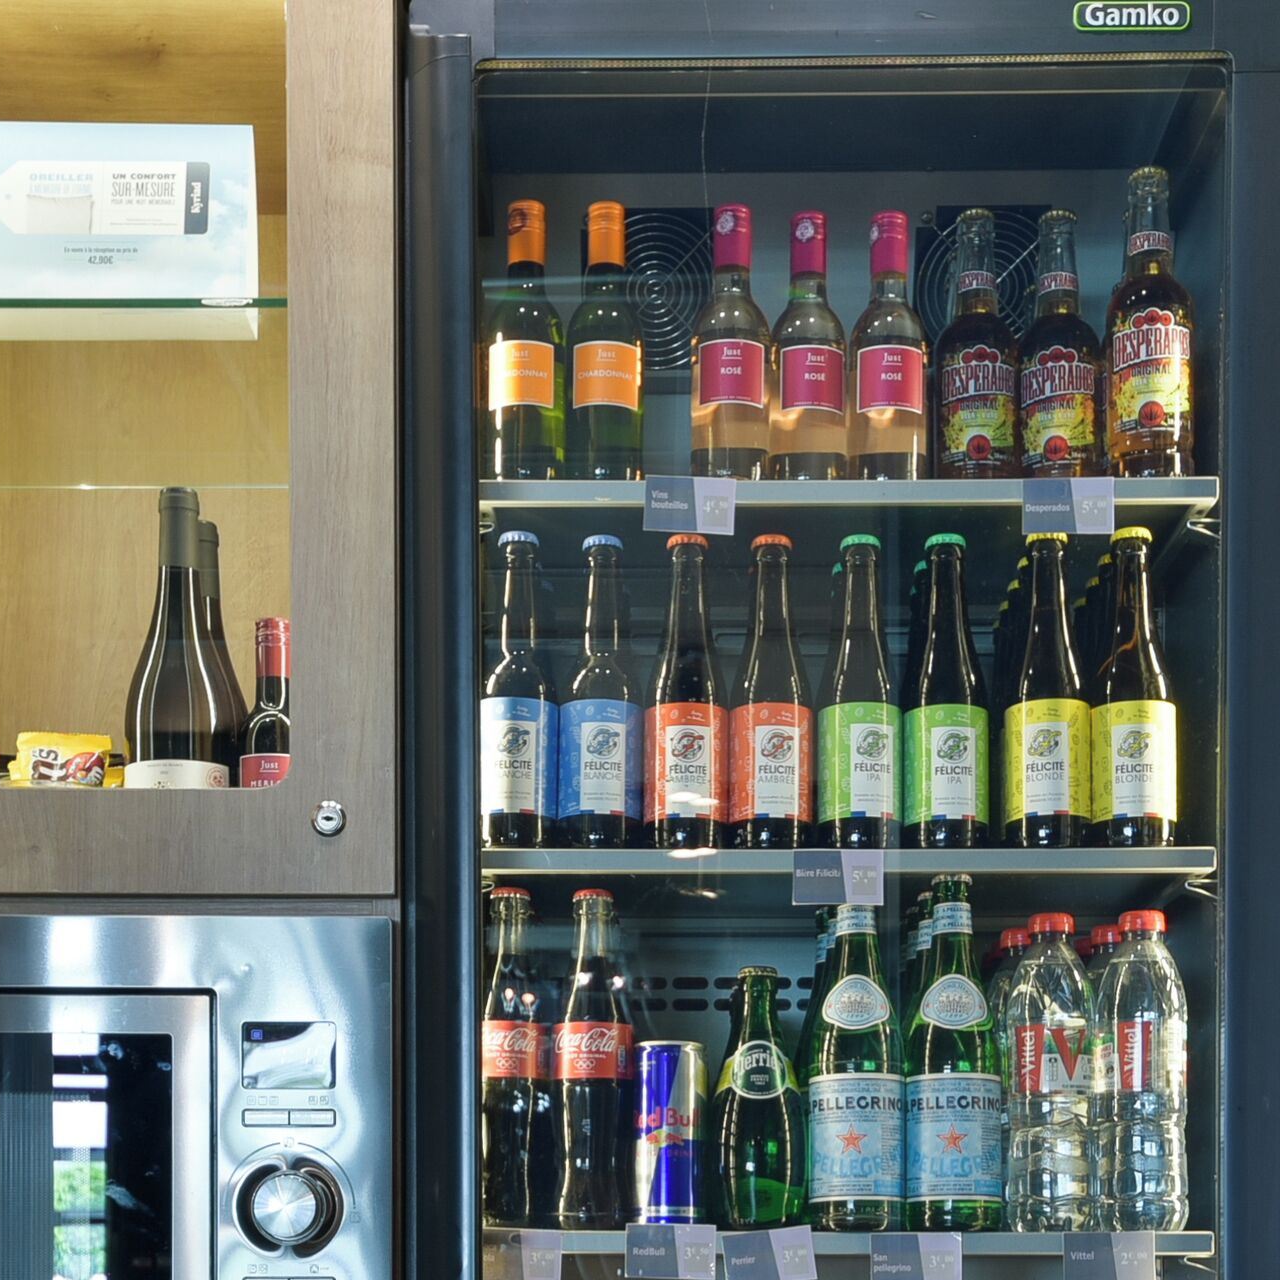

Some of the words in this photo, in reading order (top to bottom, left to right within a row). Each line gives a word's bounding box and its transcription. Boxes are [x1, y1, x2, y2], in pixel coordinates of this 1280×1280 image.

[1084, 3, 1180, 26] Gamko
[112, 172, 124, 180] UN
[130, 172, 176, 180] CONFORT
[111, 181, 176, 198] SUR-MESURE
[190, 181, 203, 214] Kyriad
[722, 346, 742, 357] Just
[806, 352, 826, 363] Just
[883, 352, 902, 363] Just
[720, 365, 742, 375] ROSÉ
[804, 371, 826, 382] ROSÉ
[880, 371, 903, 381] ROSÉ
[1021, 364, 1095, 406] DESPERADOS
[1024, 503, 1071, 515] Desperados
[260, 759, 279, 770] Just
[583, 759, 623, 772] FÉLICITÉ
[669, 763, 707, 775] FÉLICITÉ
[758, 763, 796, 775] FÉLICITÉ
[854, 761, 892, 774] FÉLICITÉ
[934, 764, 973, 776] FÉLICITÉ
[1025, 759, 1065, 773] FÉLICITÉ
[583, 771, 623, 781] BLANCHE
[866, 773, 882, 782] IPA
[946, 775, 962, 785] IPA
[1025, 771, 1065, 783] BLONDE
[555, 1027, 619, 1054] Coca-Cola
[1021, 1030, 1036, 1075] Vittel
[1123, 1027, 1138, 1072] Vittel
[666, 1107, 701, 1128] Bull
[632, 1246, 666, 1256] RedBull
[1070, 1251, 1095, 1261] Vittel
[731, 1255, 756, 1266] Perrier
[873, 1253, 888, 1262] San
[873, 1263, 912, 1274] pellegrino
